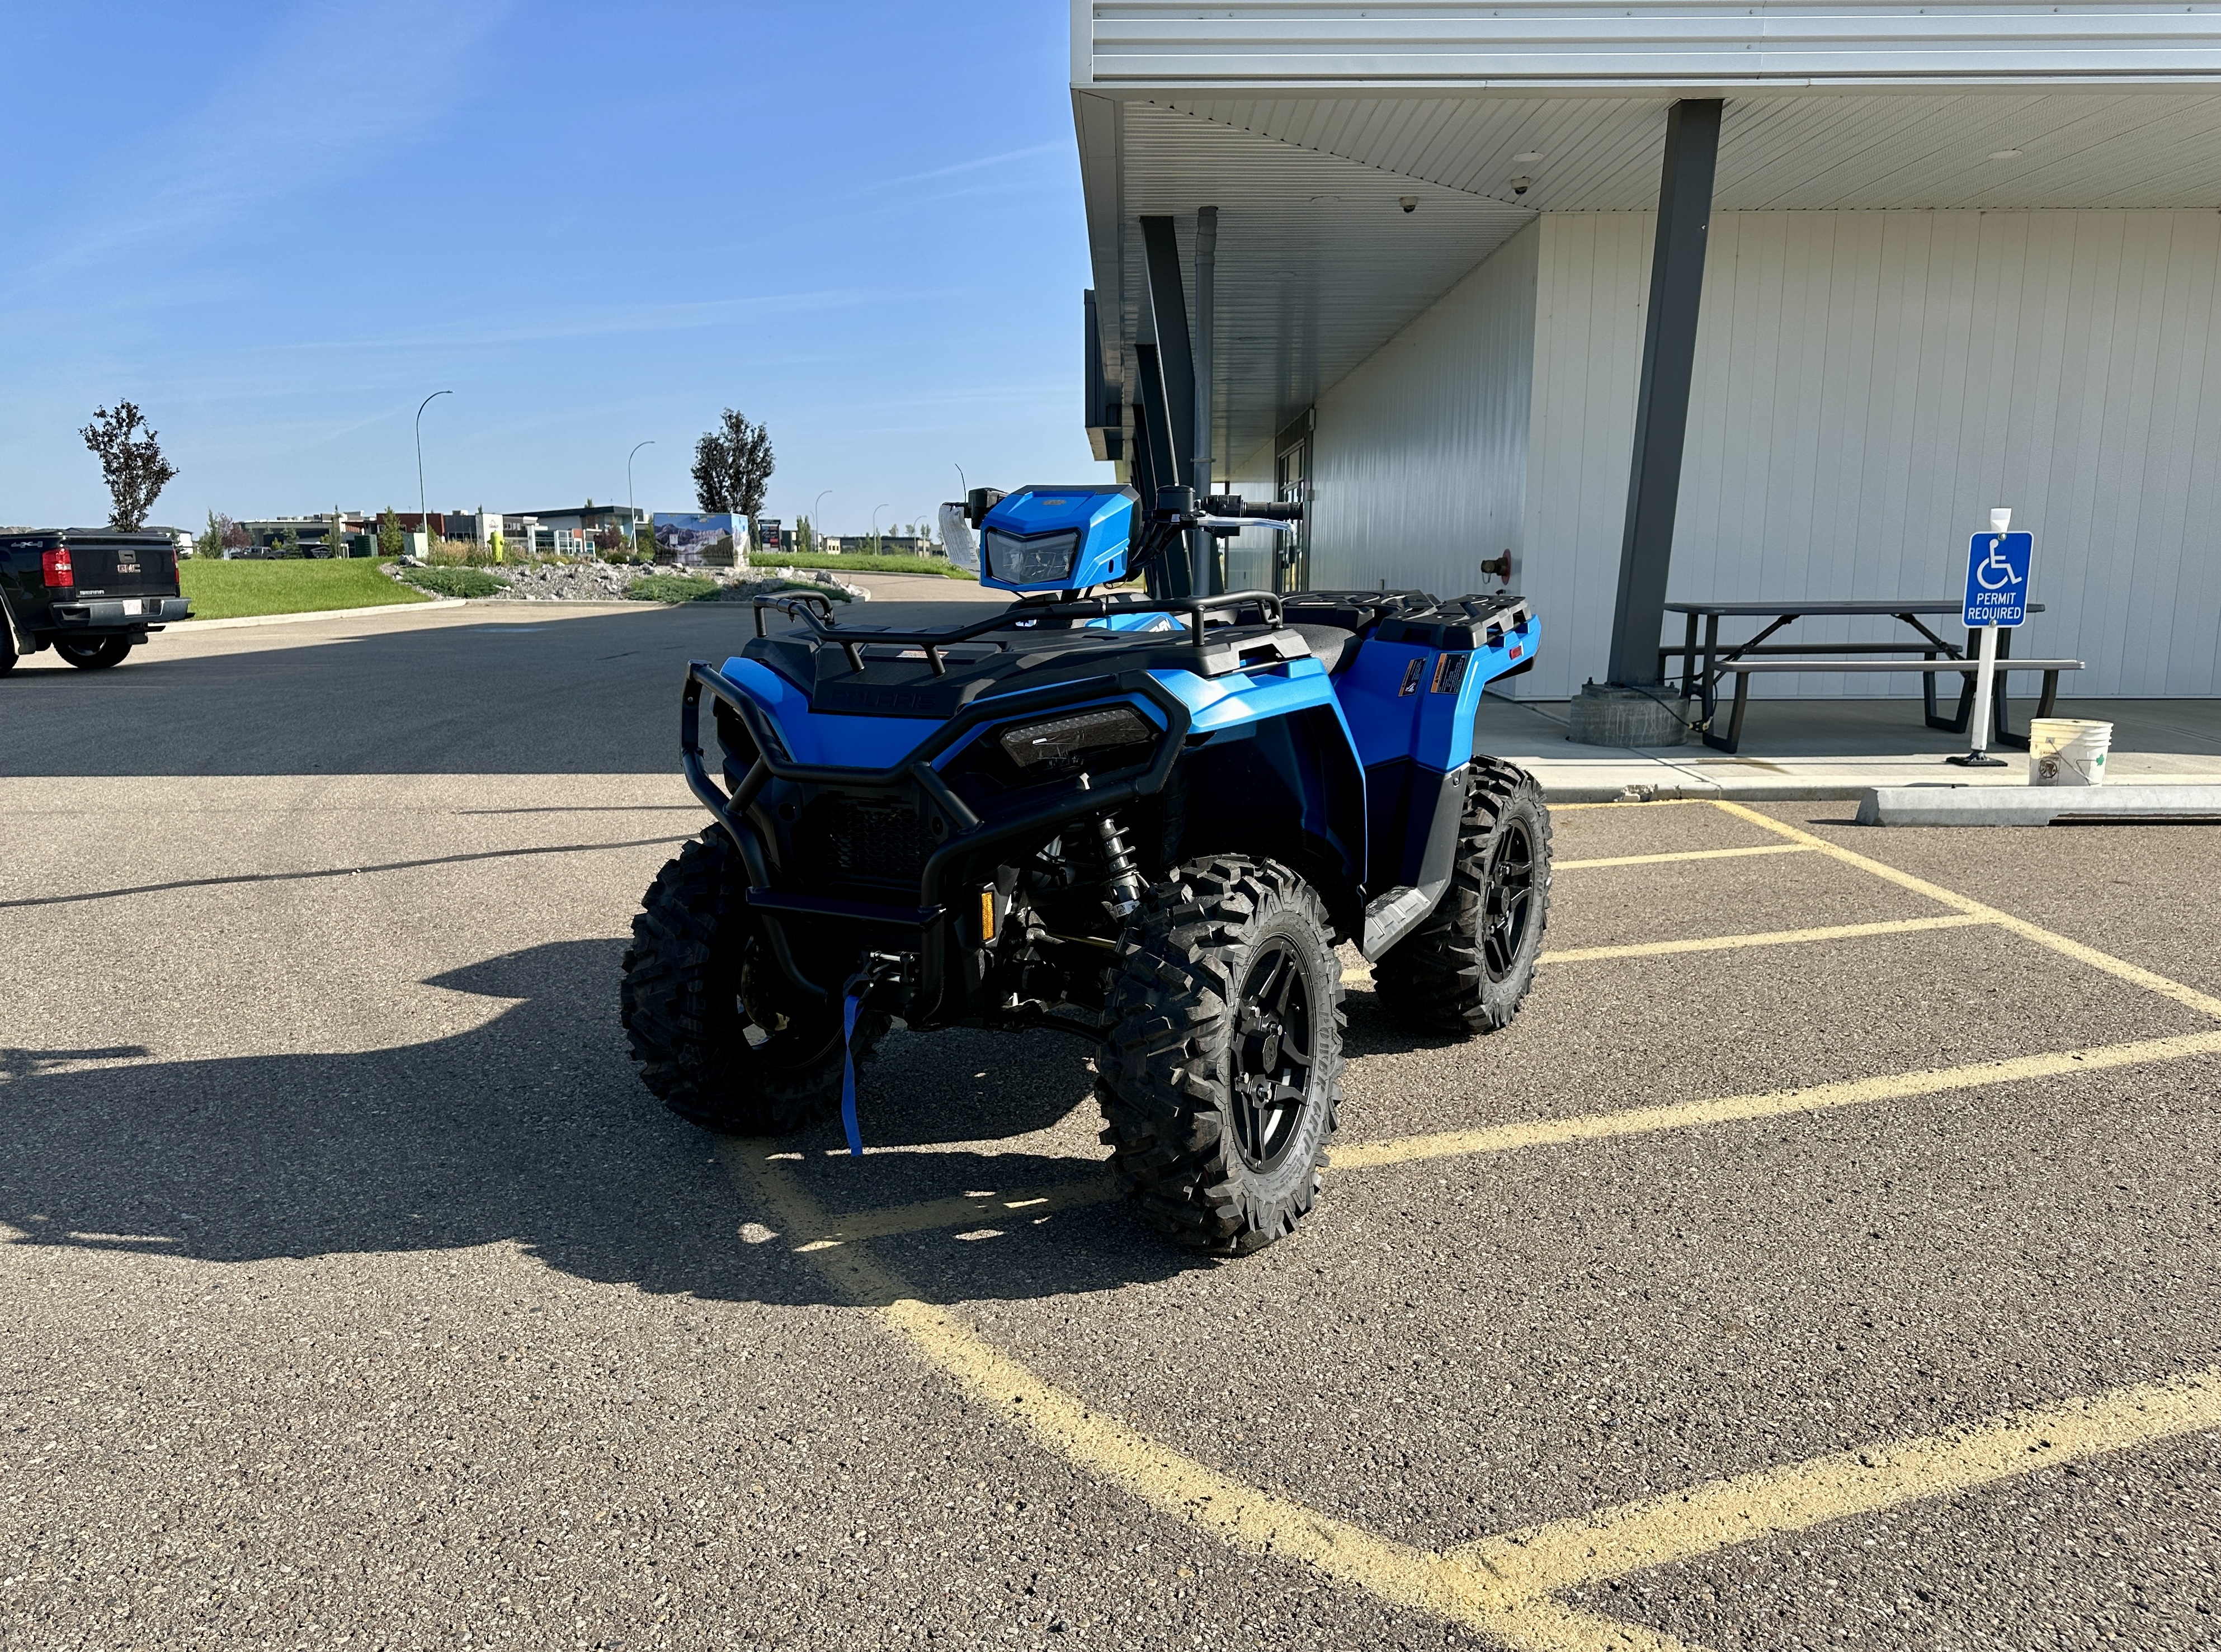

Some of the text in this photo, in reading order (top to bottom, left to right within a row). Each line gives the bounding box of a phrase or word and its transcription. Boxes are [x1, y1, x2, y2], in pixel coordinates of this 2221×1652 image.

[117, 564, 141, 573] GMC
[1977, 592, 2016, 605] PERMIT
[1968, 607, 2021, 620] REQUIRED
[830, 689, 936, 710] POLARIS
[1303, 1011, 1329, 1156] POWER GRIP
